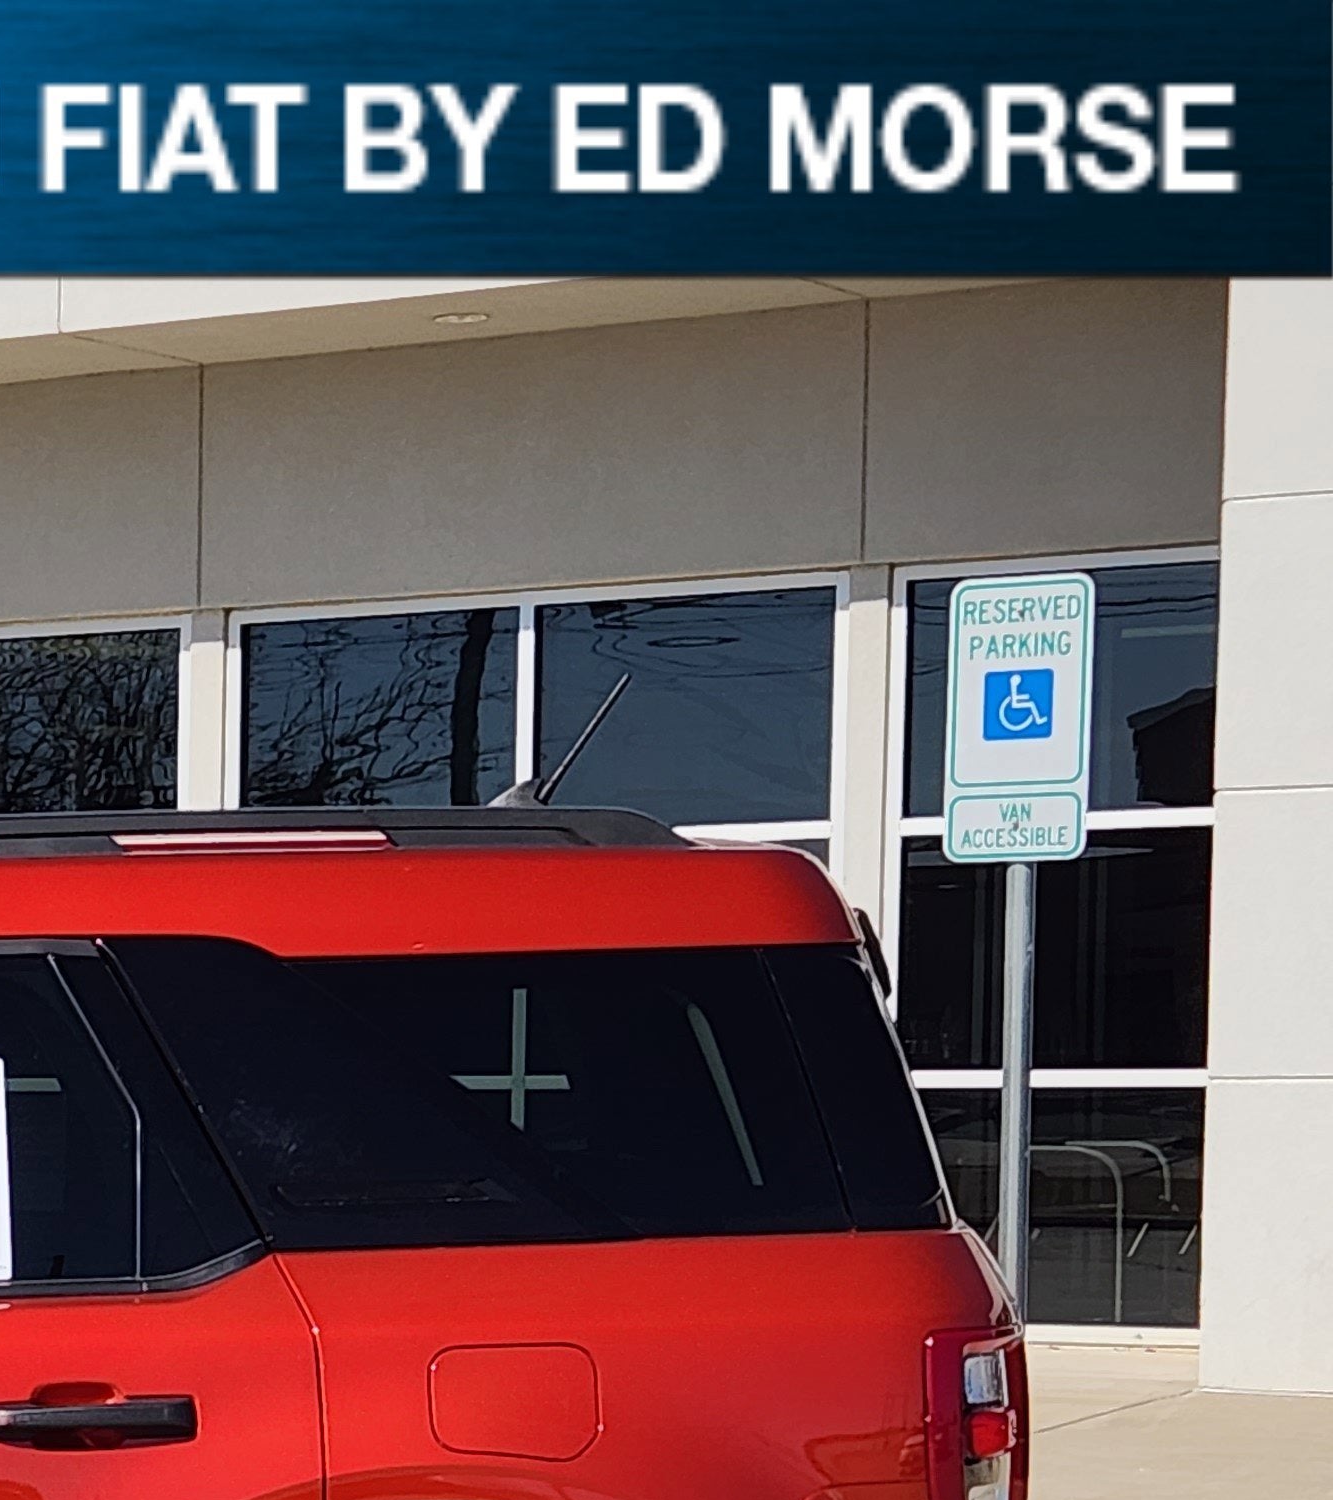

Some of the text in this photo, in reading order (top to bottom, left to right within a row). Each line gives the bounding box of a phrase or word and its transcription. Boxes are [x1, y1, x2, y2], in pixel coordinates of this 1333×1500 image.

[962, 593, 1082, 626] RESERVED
[968, 629, 1072, 661] PARKING
[998, 802, 1032, 823] VAN
[960, 825, 1069, 849] ACCESSIBLE
